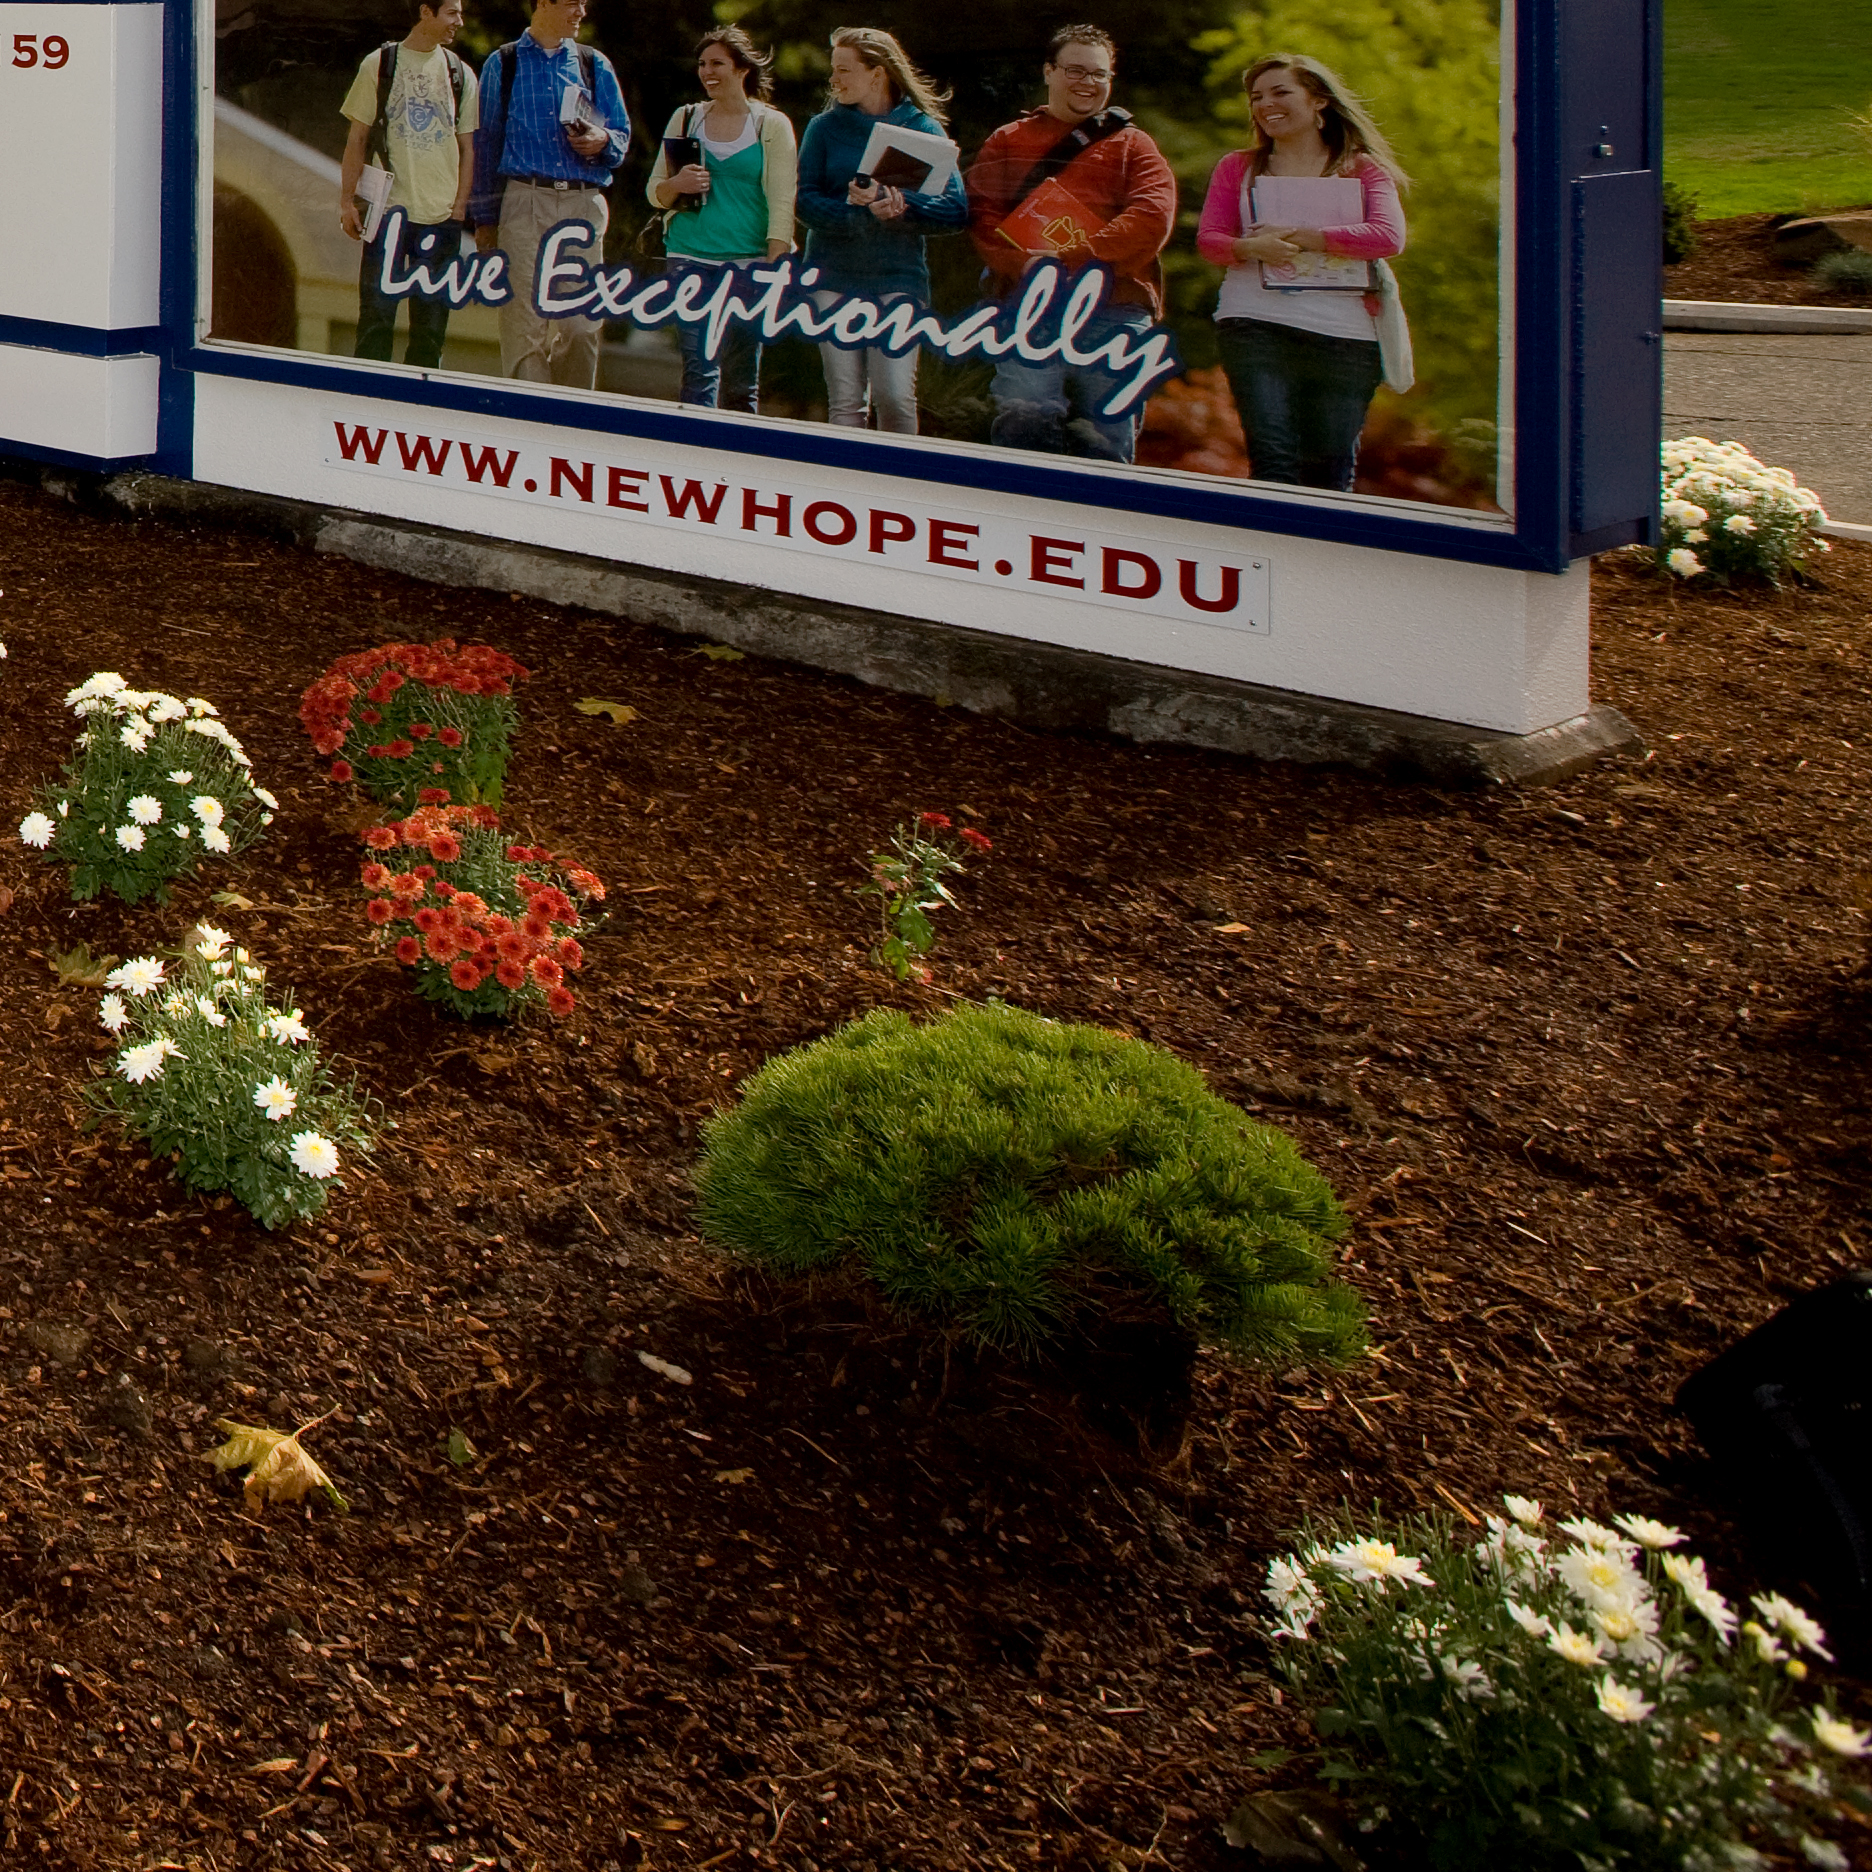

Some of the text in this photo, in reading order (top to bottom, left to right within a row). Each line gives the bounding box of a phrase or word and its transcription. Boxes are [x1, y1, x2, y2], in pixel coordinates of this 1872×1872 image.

[380, 211, 1174, 416] Live Exceptionally
[333, 420, 1242, 614] WWW.NEWHOPE.EDU
